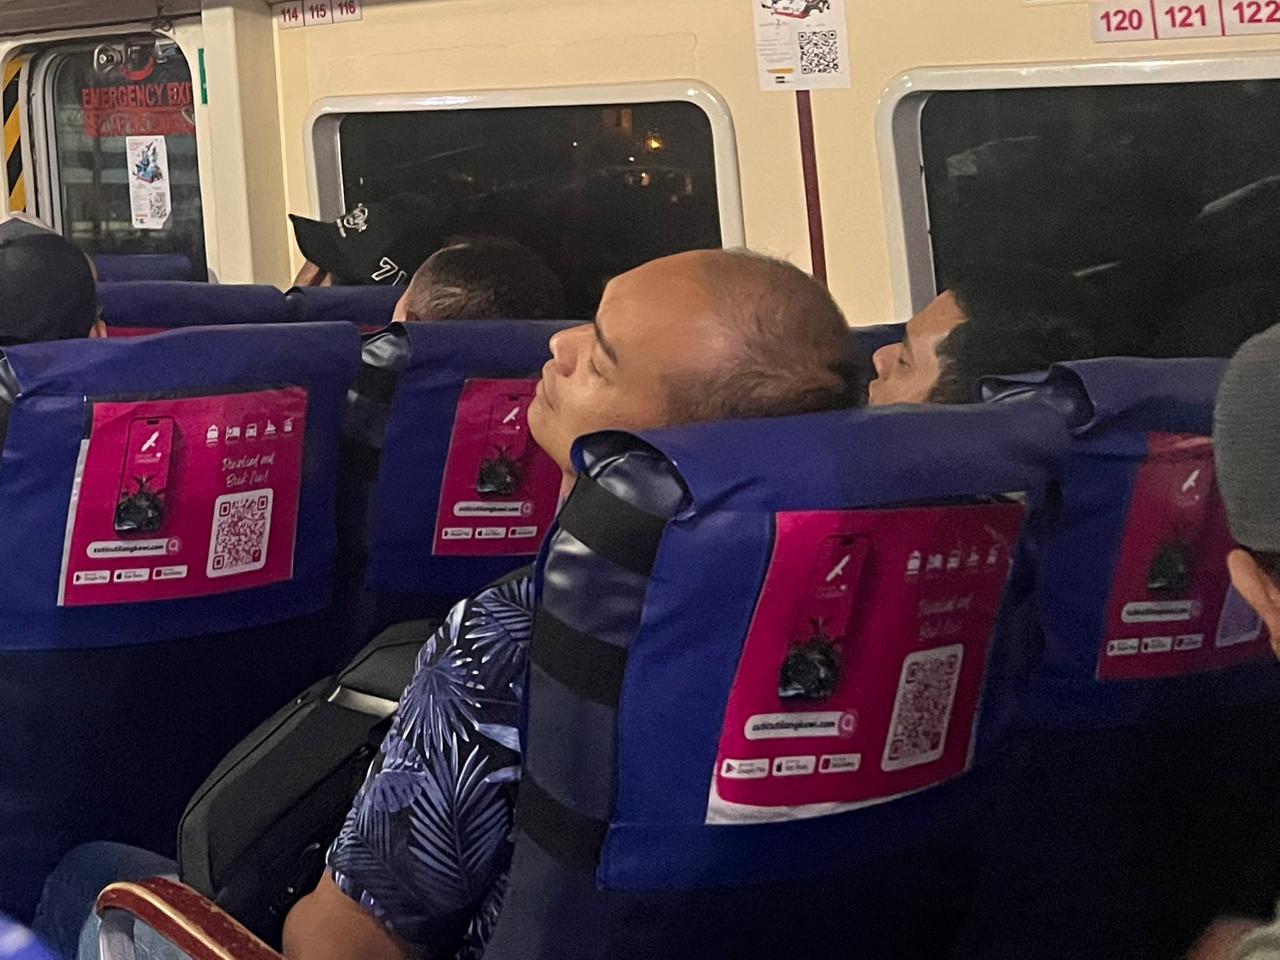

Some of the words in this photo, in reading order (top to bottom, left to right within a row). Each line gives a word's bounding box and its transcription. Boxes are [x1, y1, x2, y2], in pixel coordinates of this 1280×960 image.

[281, 7, 299, 22] 114
[309, 4, 326, 19] 115
[338, 0, 356, 16] 116
[1099, 8, 1144, 32] 120
[1164, 4, 1207, 29] 121
[1232, 0, 1280, 25] 122
[82, 83, 163, 108] EMERGENCY
[168, 81, 192, 105] EXI
